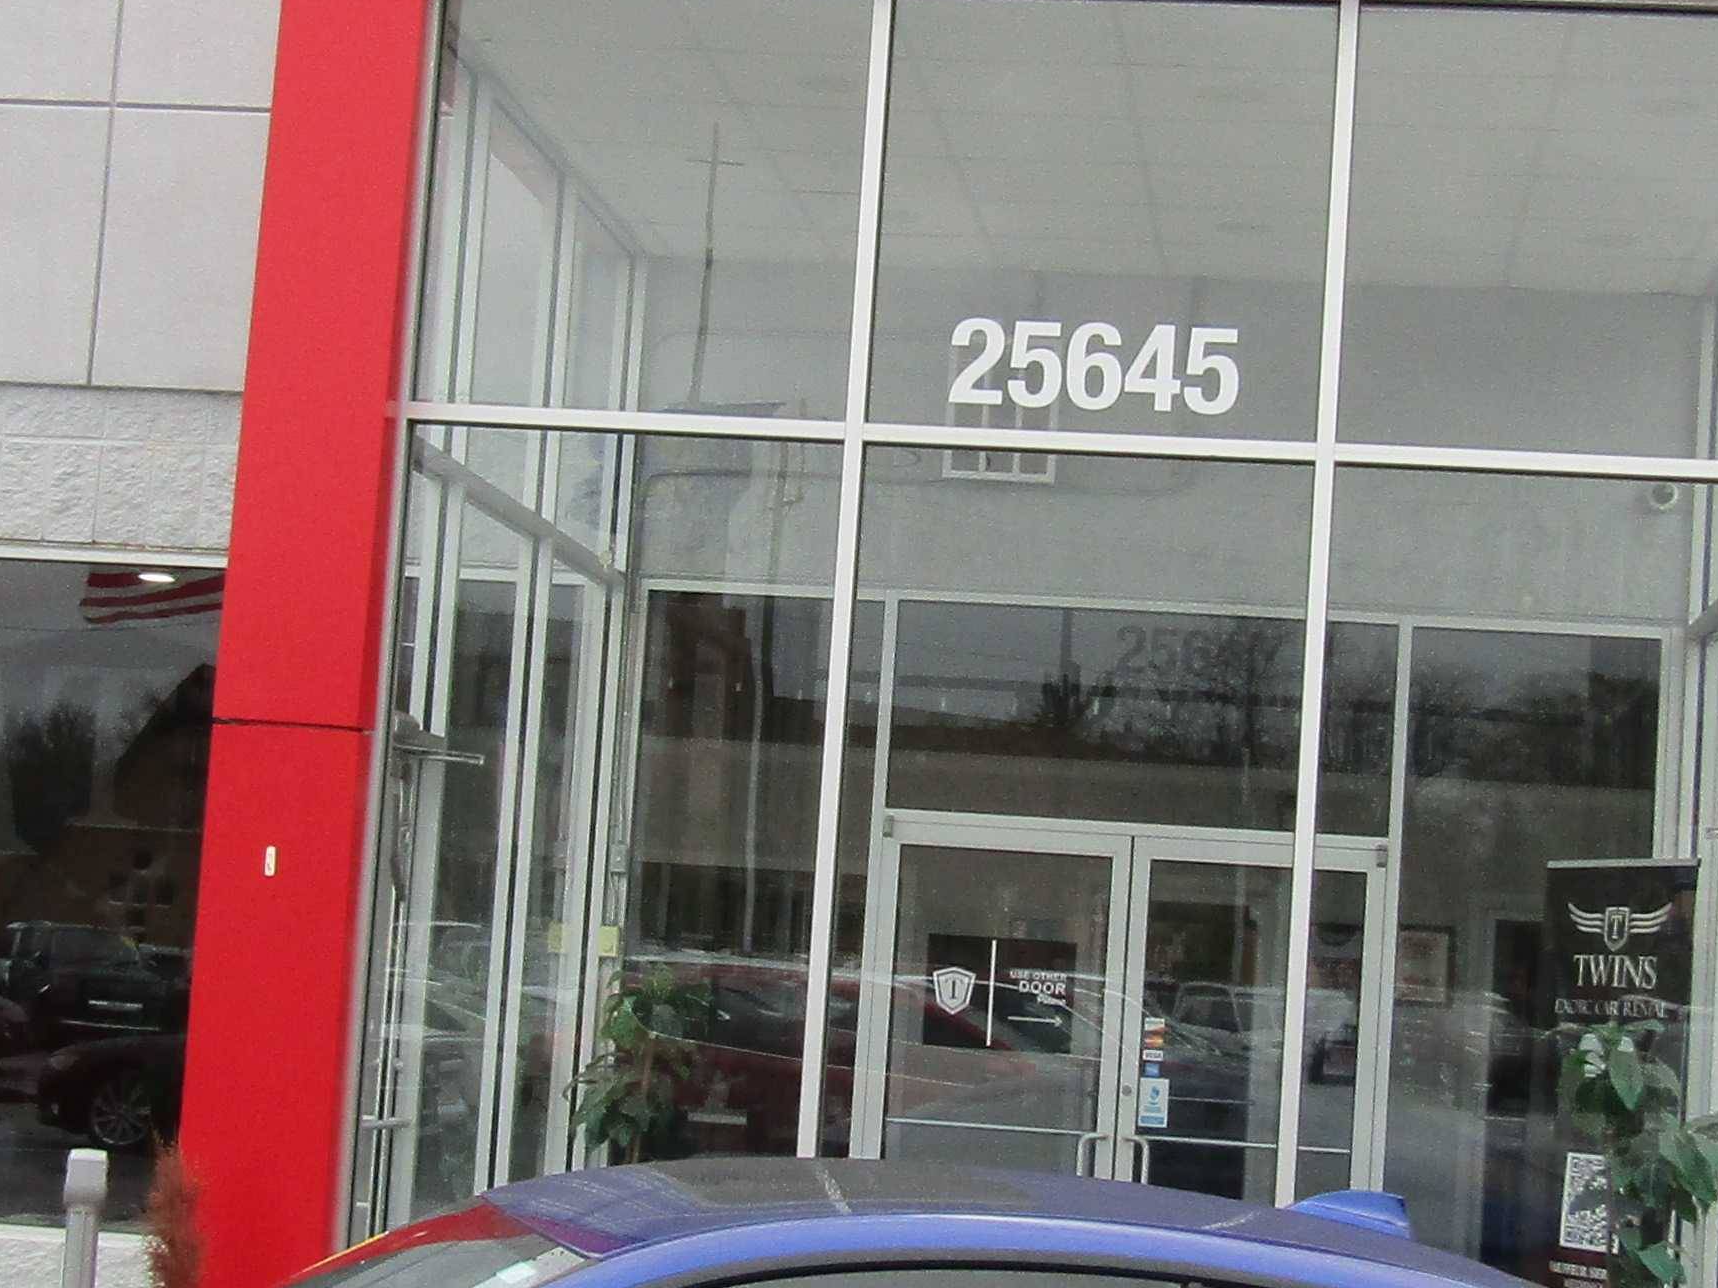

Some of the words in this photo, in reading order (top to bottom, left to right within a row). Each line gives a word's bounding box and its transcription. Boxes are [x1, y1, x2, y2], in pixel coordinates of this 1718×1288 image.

[948, 318, 1239, 415] 25645
[1611, 914, 1622, 939] T
[1033, 971, 1067, 982] OTHER
[1573, 954, 1658, 989] TWINS
[1019, 980, 1066, 995] DOOR
